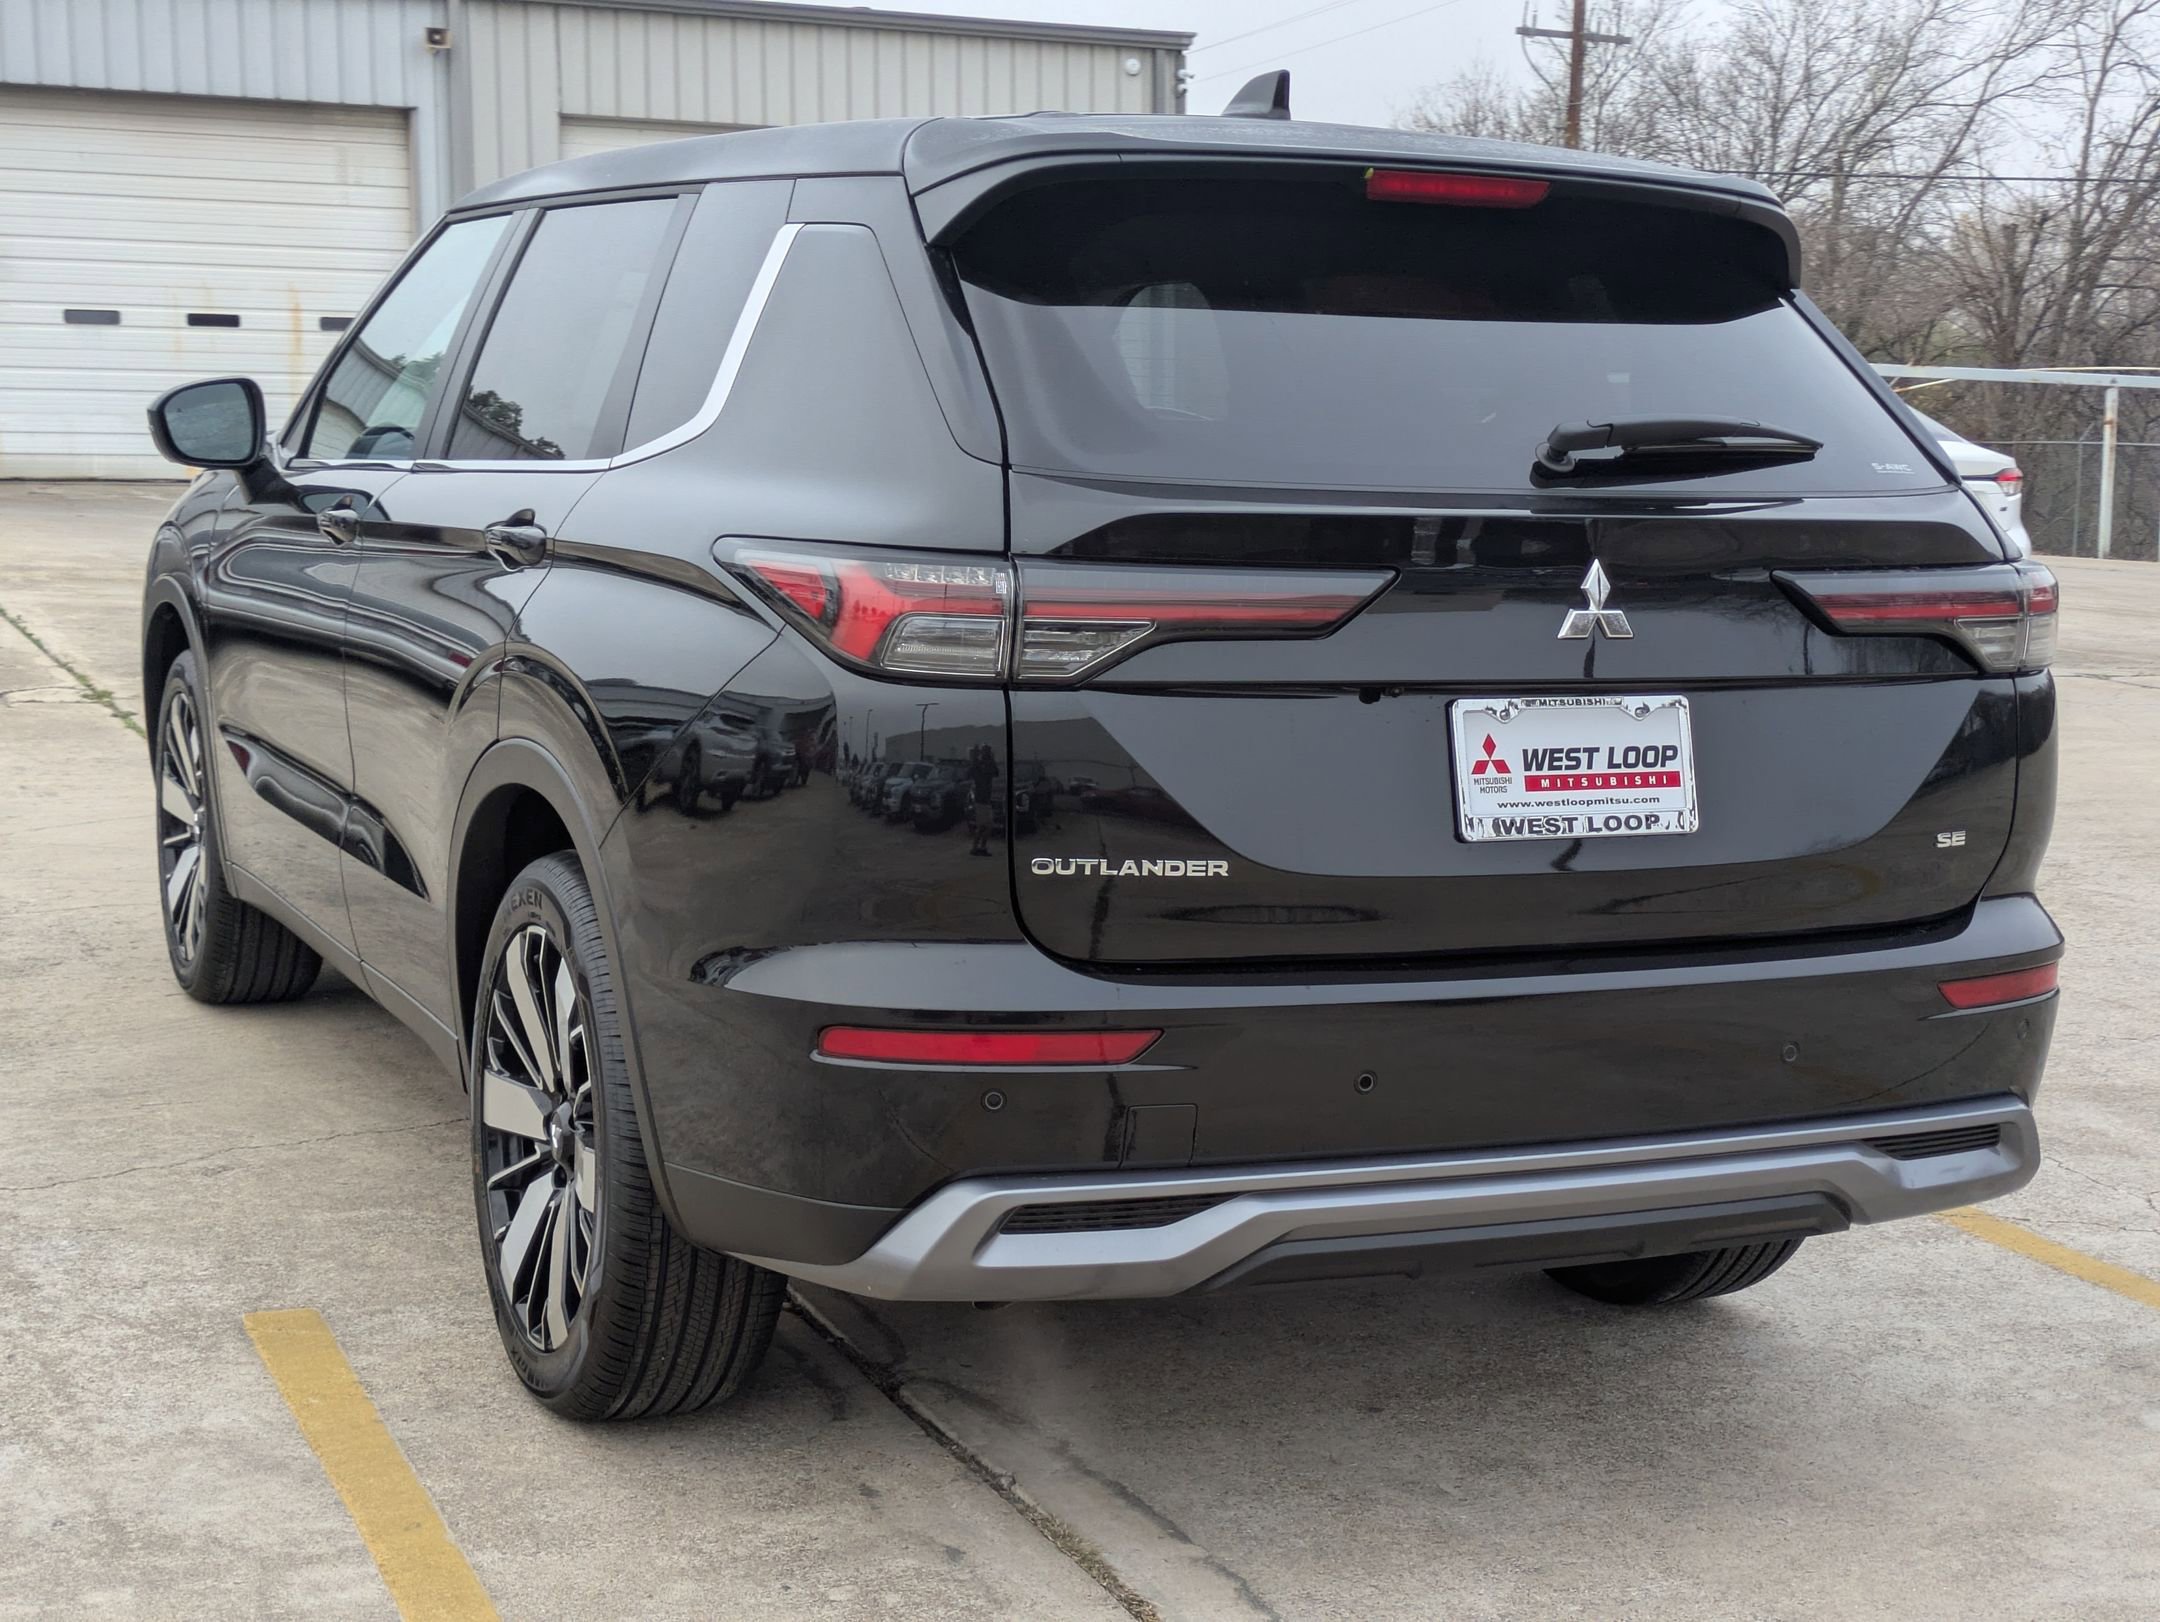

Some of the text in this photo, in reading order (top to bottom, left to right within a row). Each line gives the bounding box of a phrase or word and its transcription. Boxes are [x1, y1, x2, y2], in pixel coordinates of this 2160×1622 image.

[1538, 697, 1607, 707] MITSUBISHI
[1522, 744, 1679, 772] WEST LOOP
[1473, 777, 1512, 786] MITSUBISHI
[1541, 775, 1668, 788] MITSUBISHI
[1479, 786, 1508, 794] MOTORS
[1497, 796, 1660, 809] www.westloopmitsu.com
[1500, 813, 1660, 836] WEST LOOP
[1936, 830, 1966, 848] SE
[1031, 857, 1230, 877] OUTLANDER
